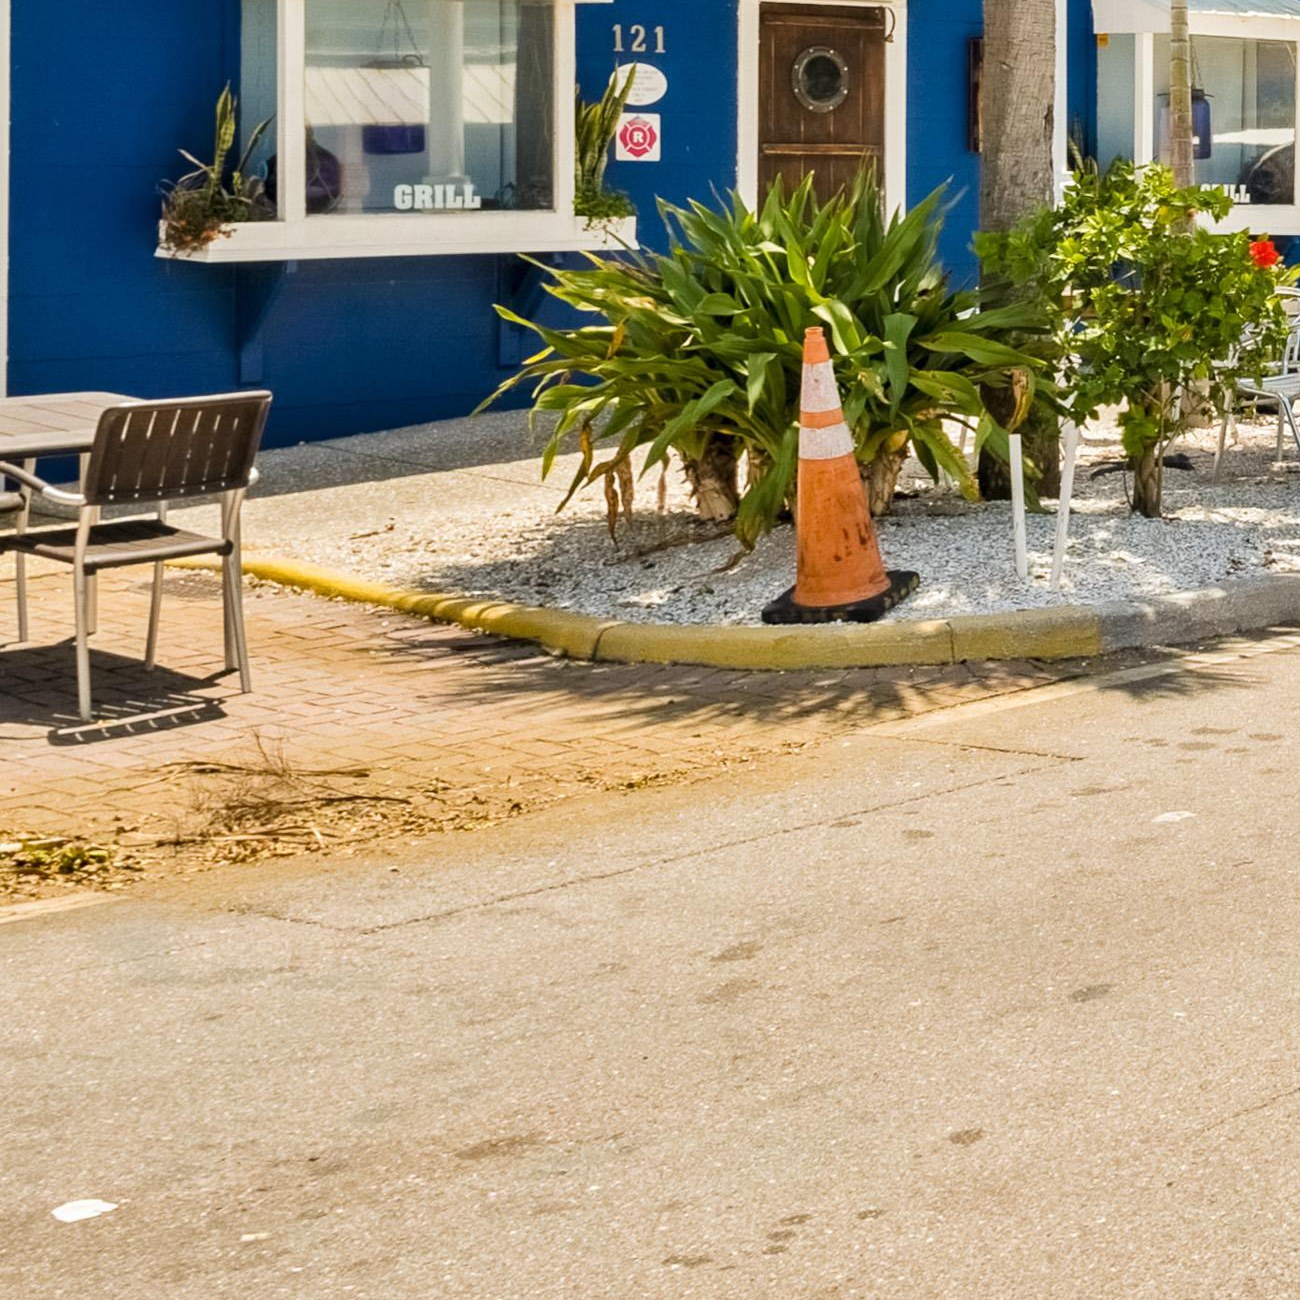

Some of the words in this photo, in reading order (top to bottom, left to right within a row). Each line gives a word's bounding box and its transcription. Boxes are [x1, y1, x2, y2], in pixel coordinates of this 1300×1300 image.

[612, 23, 667, 54] 121
[632, 131, 645, 143] R
[393, 184, 482, 210] GRILL
